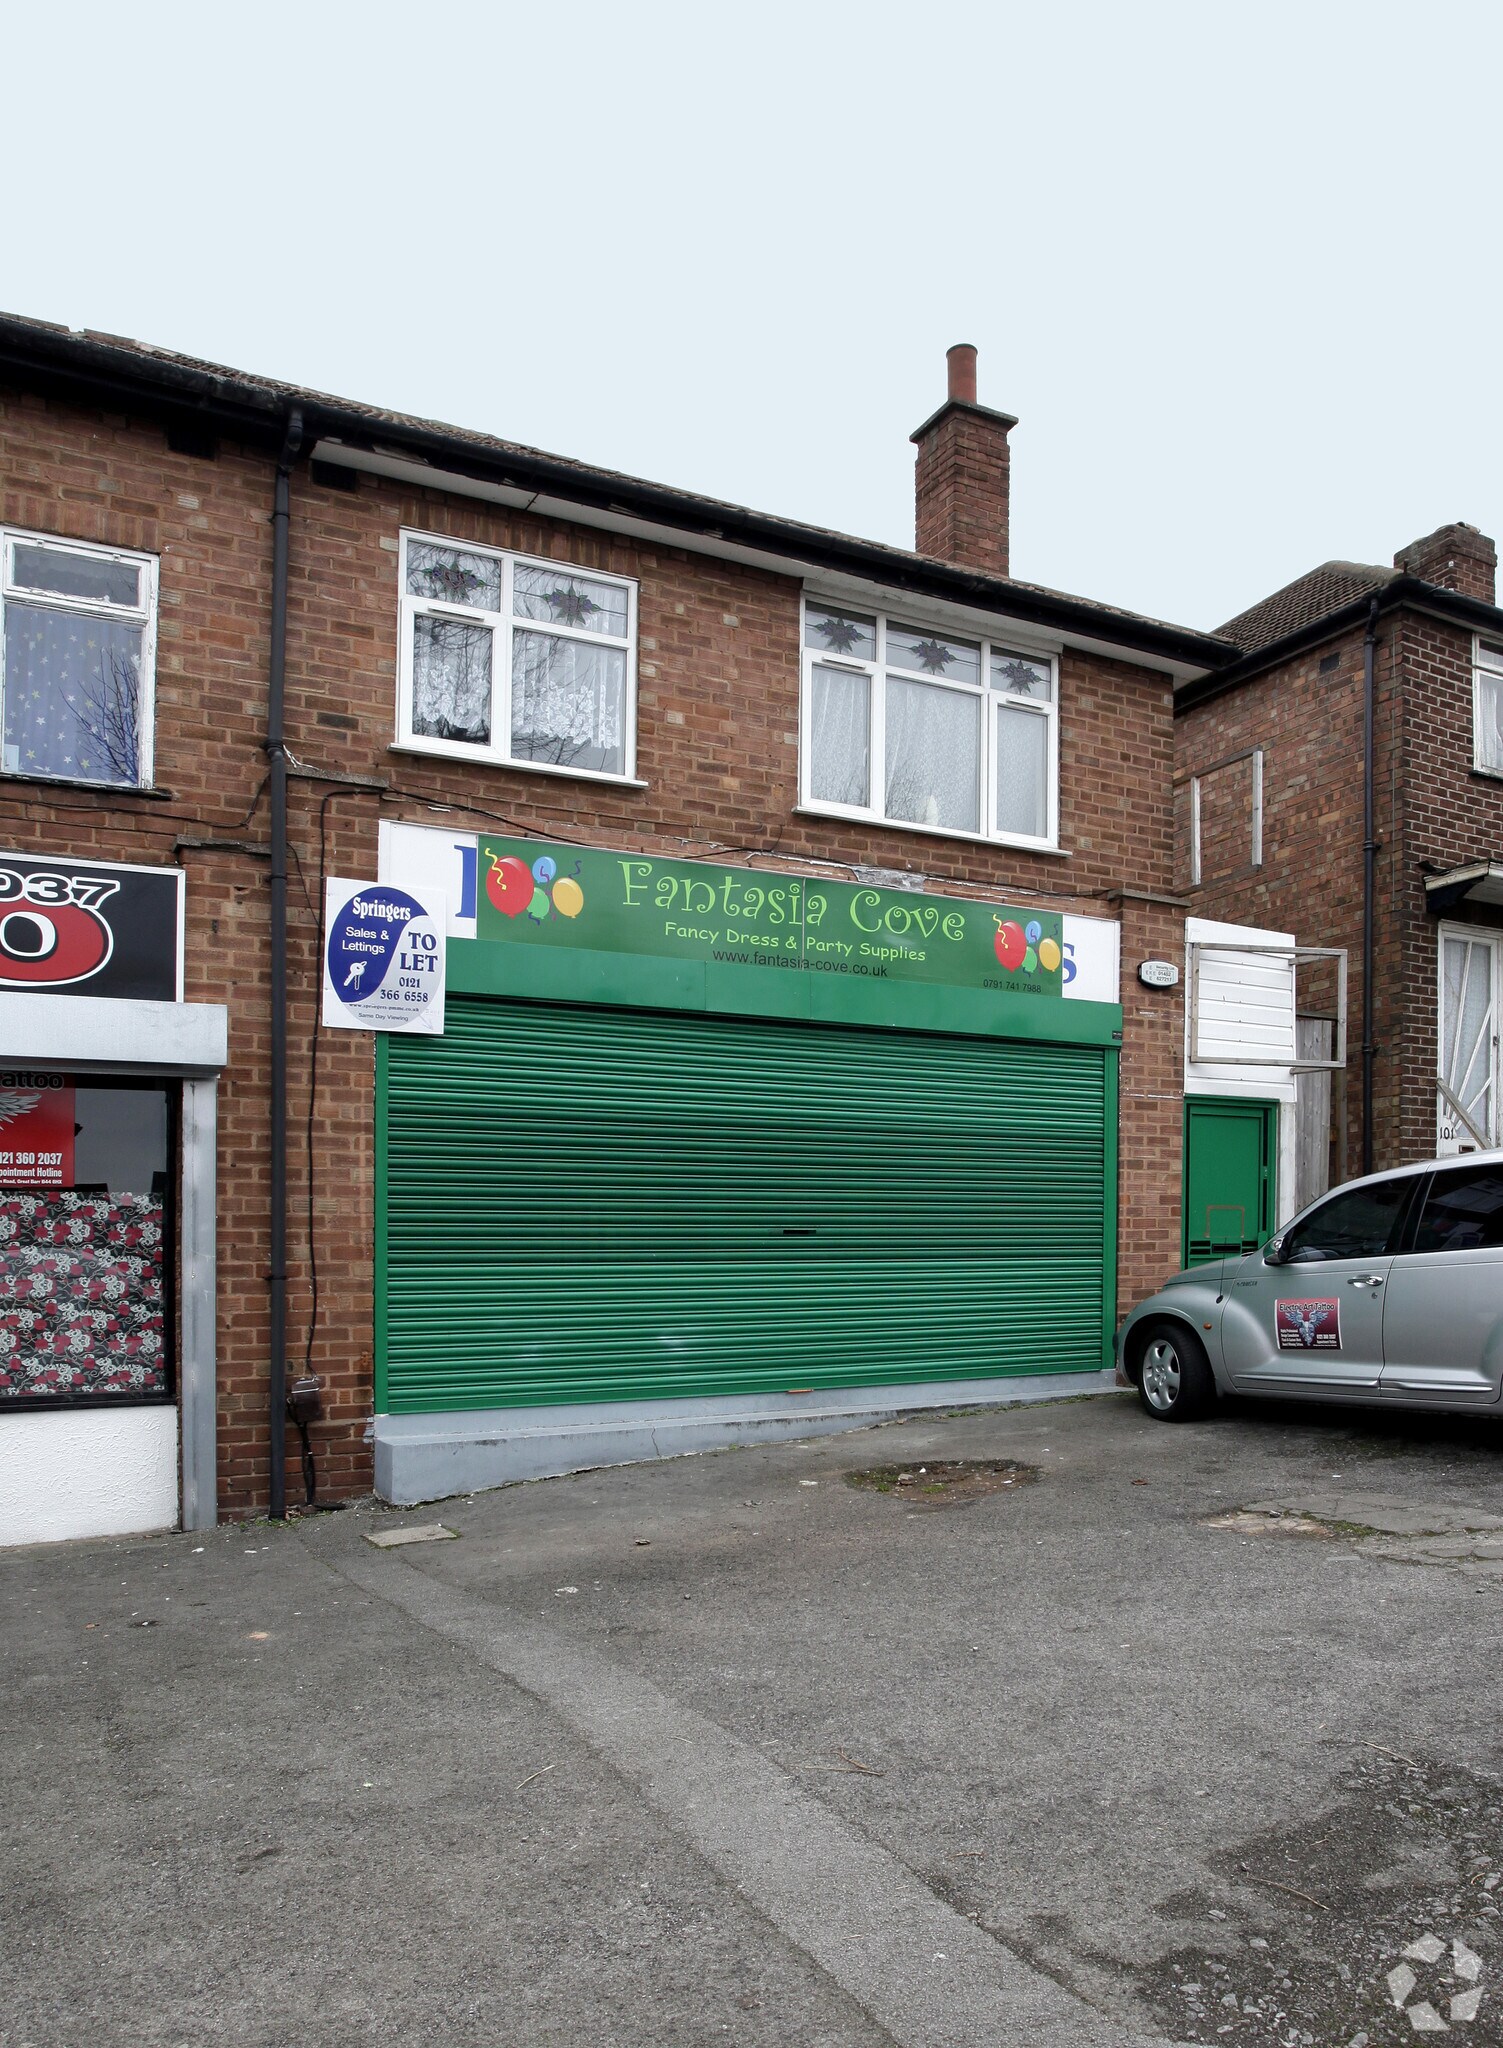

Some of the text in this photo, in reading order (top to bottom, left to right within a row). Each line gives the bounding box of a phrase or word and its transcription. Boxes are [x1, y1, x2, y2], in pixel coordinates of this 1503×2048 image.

[617, 860, 966, 942] Fantasia Cove
[352, 896, 411, 923] Springers
[345, 926, 389, 941] Sales &
[408, 931, 438, 951] TO
[342, 940, 386, 955] Lettings
[665, 921, 926, 962] Fancy Dress & Party Supplies
[400, 952, 438, 973] LET
[713, 949, 889, 978] www.fantasia-cove.co.uk
[399, 977, 421, 989] 0121
[983, 979, 1003, 989] 0791
[1006, 981, 1020, 990] 741
[380, 989, 429, 1003] 366 6558
[1440, 1126, 1454, 1140] 101
[16, 1152, 36, 1165] 360
[37, 1152, 63, 1165] 2037
[36, 1167, 63, 1178] Hotline
[1314, 1302, 1335, 1311] Tattoo
